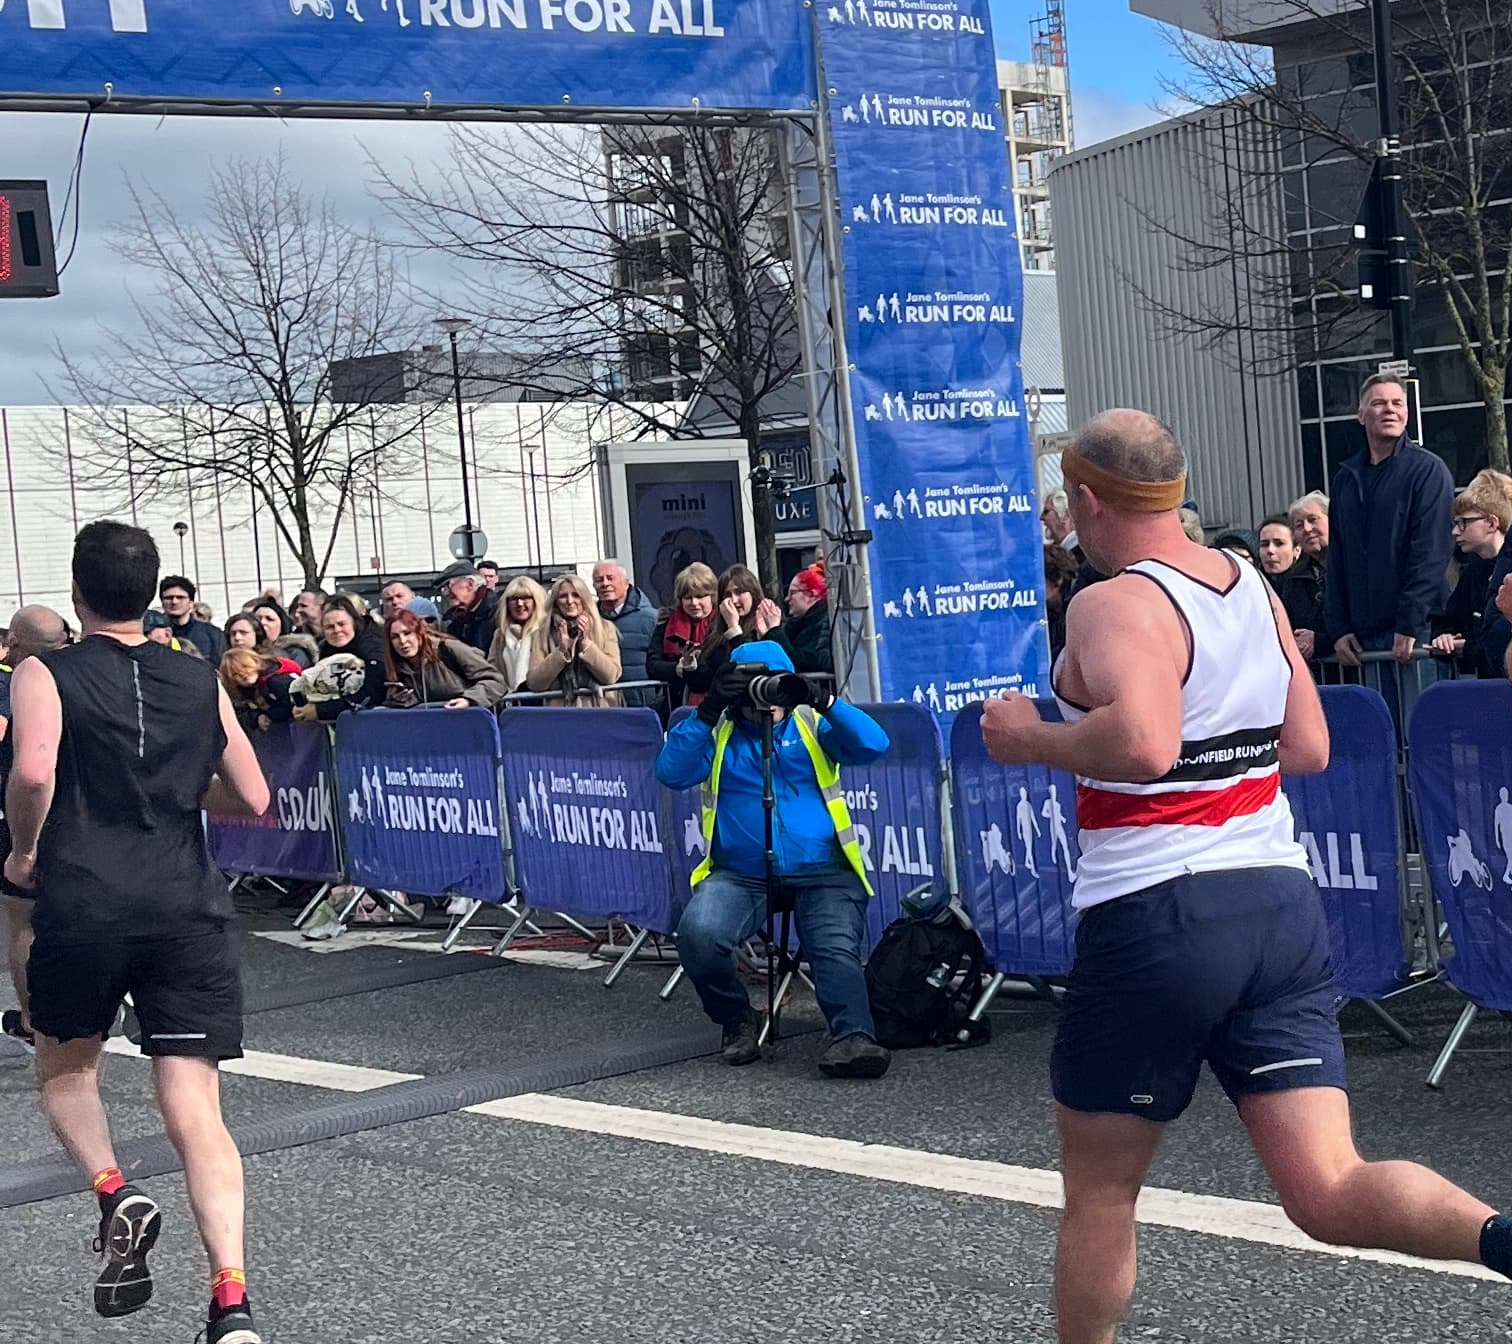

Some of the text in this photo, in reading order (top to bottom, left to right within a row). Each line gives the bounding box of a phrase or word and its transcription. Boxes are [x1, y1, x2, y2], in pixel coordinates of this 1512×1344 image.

[899, 0, 958, 11] Tomlinson's
[873, 11, 985, 34] RUN FOR ALL
[888, 95, 971, 108] Jane Tomlinson's
[888, 108, 996, 131] RUN FOR ALL
[899, 194, 982, 205] Jane Tomlinson's
[900, 207, 1008, 227] RUN FOR ALL
[905, 291, 991, 303] Jane Tomlinson's
[905, 304, 1015, 323] RUN FOR ALL
[912, 388, 997, 401] Jane Tomlinson's
[912, 400, 1020, 421] RUN FOR ALL
[924, 482, 1009, 497] Jane Tomlinson's
[662, 493, 706, 511] mini
[775, 502, 811, 521] UXE
[925, 495, 1032, 517] RUN FOR ALL
[934, 578, 1015, 595] Jane Tomlinson's
[935, 589, 1038, 615] RUN FOR ALL
[945, 680, 971, 692] Jane
[944, 691, 986, 712] RUN
[1021, 683, 1040, 699] ALL
[384, 765, 464, 789] Jane Tomlinson's
[550, 770, 628, 798] Jane Tomlinson's
[387, 794, 498, 837] RUN FOR ALL
[553, 803, 664, 853] RUN FOR ALL
[881, 824, 934, 877] ALL
